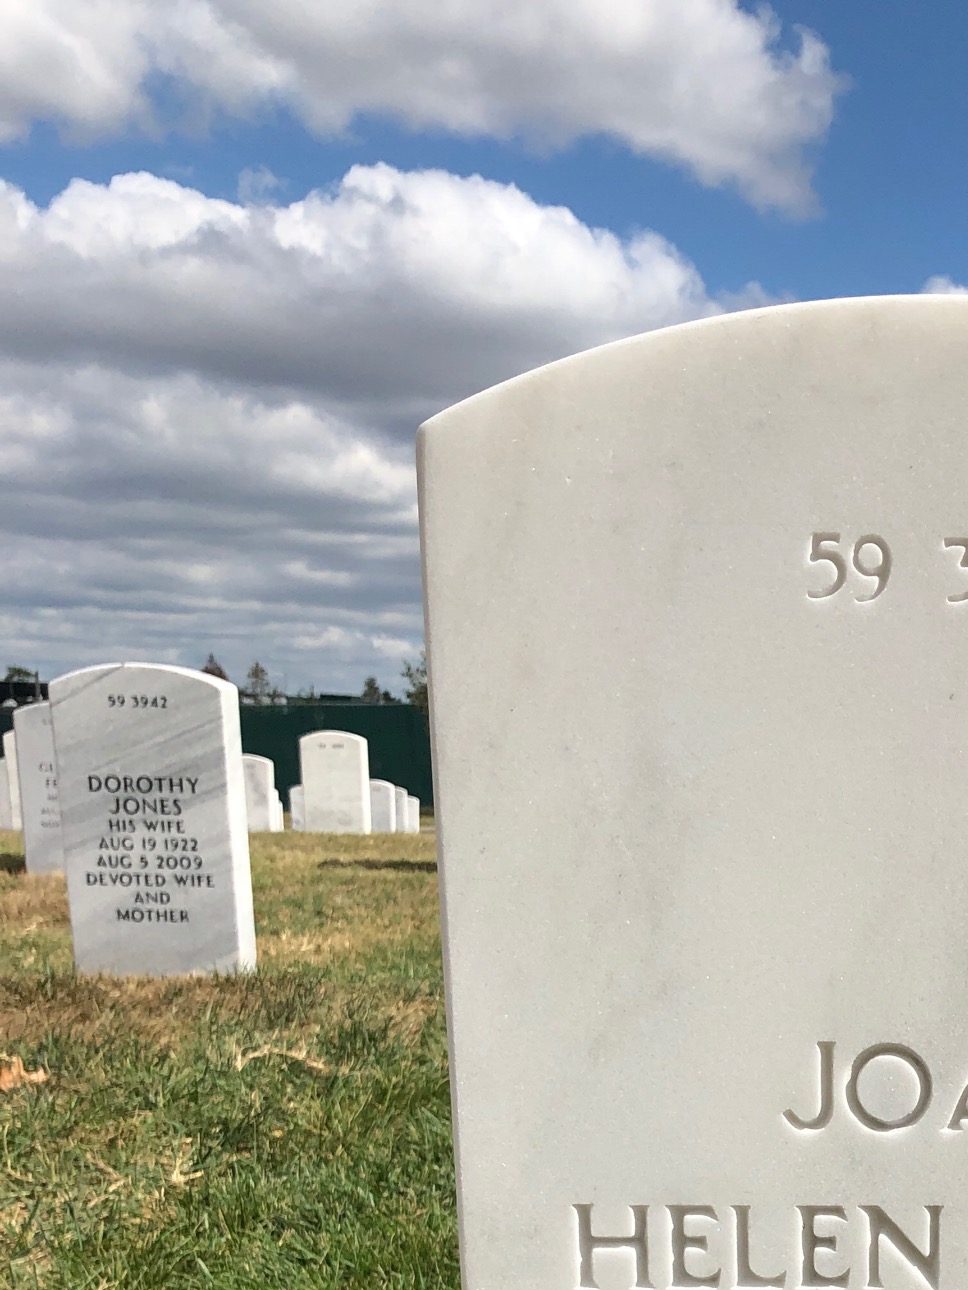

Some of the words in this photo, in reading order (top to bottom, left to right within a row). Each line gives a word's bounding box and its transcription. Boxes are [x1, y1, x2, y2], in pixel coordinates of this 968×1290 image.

[804, 531, 892, 607] 59
[107, 694, 126, 708] 59
[130, 695, 168, 709] 3942
[87, 774, 199, 794] DOROTHY
[108, 796, 182, 816] JONES
[108, 818, 136, 833] HIS
[143, 819, 186, 834] WIFE
[99, 836, 135, 851] AUG
[141, 836, 157, 851] 19
[164, 837, 199, 852] 1922
[97, 854, 132, 869] AUG
[139, 855, 149, 869] 5
[156, 854, 203, 870] 2009
[86, 871, 167, 887] DEVOTED
[173, 873, 216, 888] WIFE
[134, 890, 171, 905] AND
[116, 907, 190, 923] MOTHER
